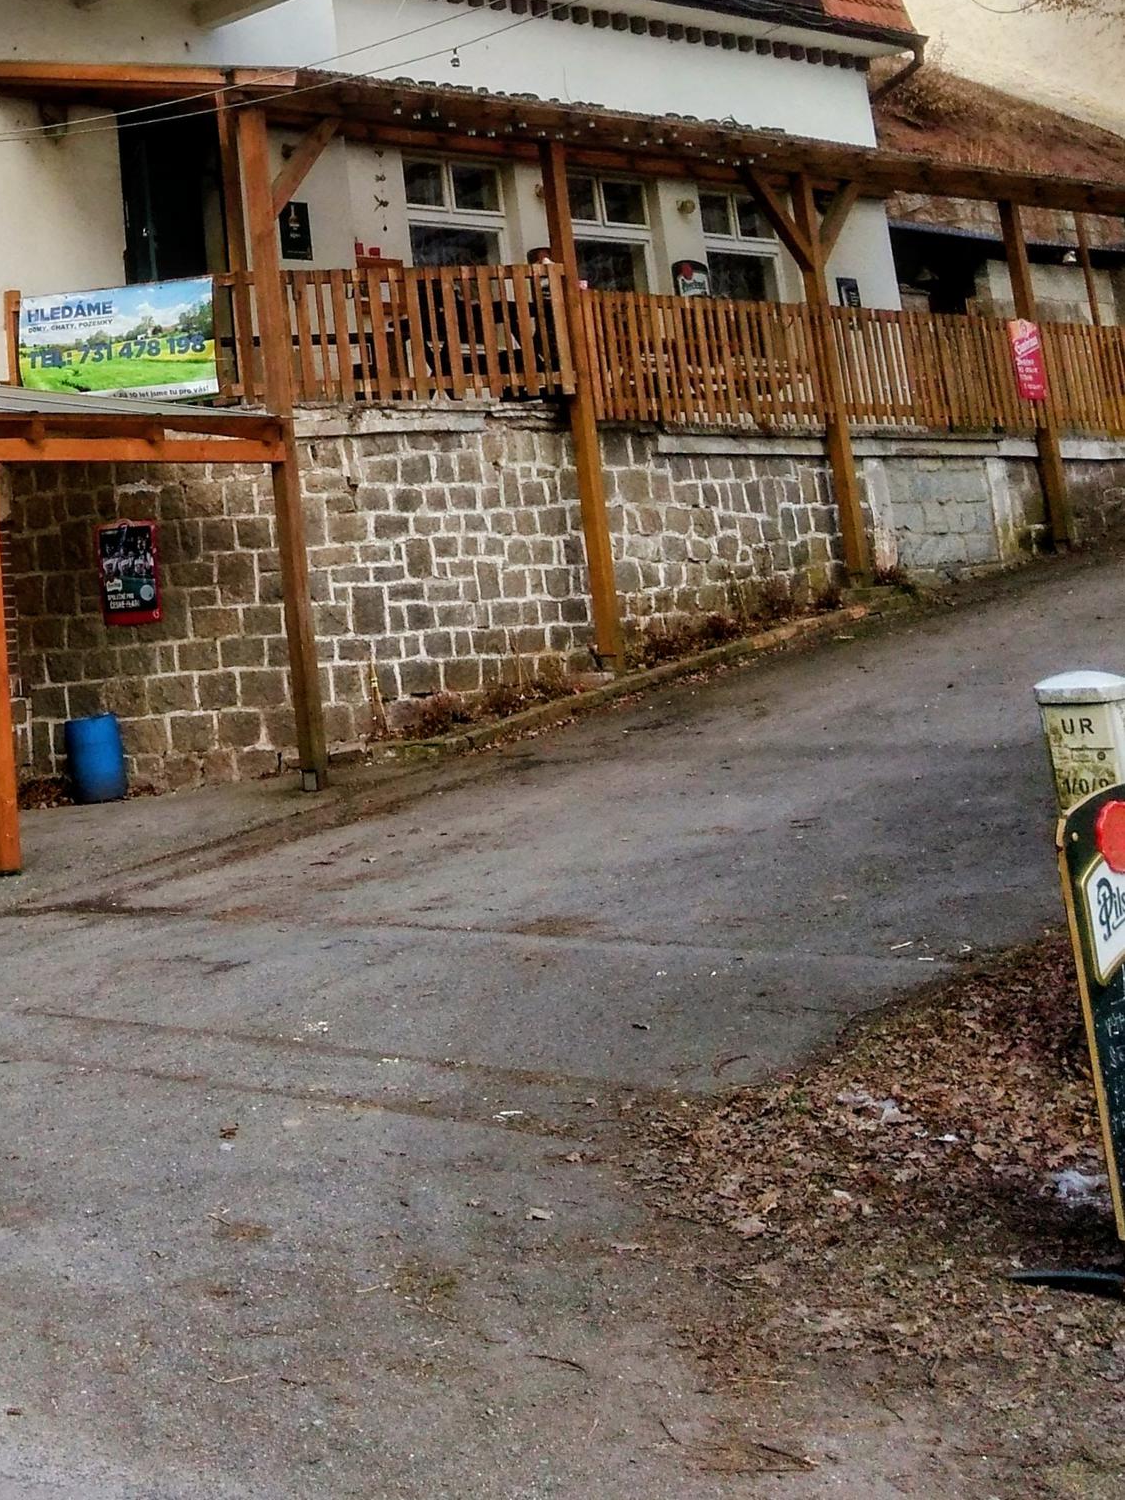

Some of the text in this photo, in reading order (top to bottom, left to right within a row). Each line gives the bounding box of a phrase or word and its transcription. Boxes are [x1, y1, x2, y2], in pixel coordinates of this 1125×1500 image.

[27, 300, 113, 323] HLEDÁME
[78, 340, 113, 364] 731
[119, 339, 161, 359] 478
[166, 332, 206, 355] 198
[169, 388, 178, 396] tu
